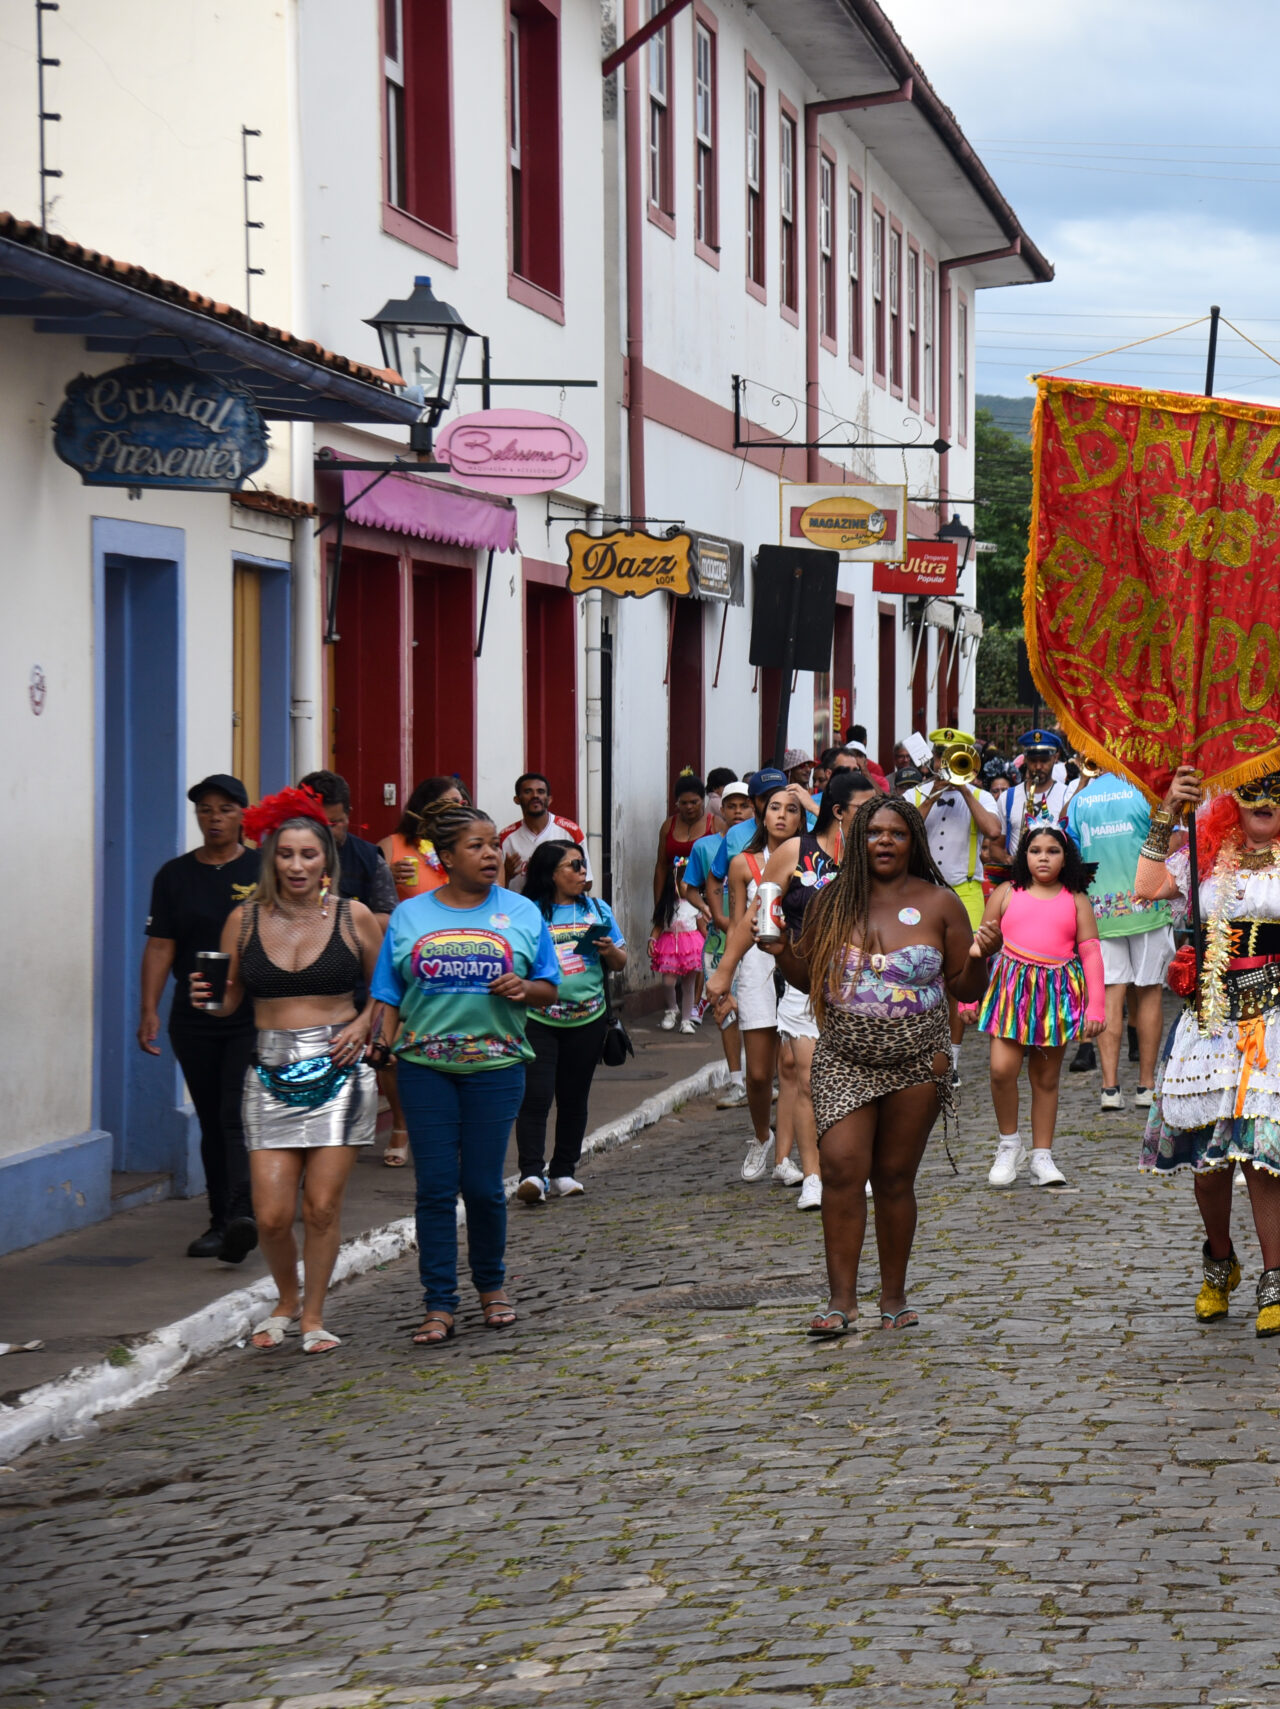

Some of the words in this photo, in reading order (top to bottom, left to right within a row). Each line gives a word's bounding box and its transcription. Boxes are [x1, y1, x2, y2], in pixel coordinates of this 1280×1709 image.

[88, 378, 232, 434] Cristal
[84, 430, 242, 480] Presentes
[809, 517, 867, 529] MAGAZINE
[1140, 493, 1259, 568] DOS
[581, 541, 678, 580] Dazz
[655, 577, 676, 585] LOOK
[917, 574, 946, 584] Popular
[1077, 788, 1134, 808] Organização
[1090, 822, 1134, 836] MARIANA
